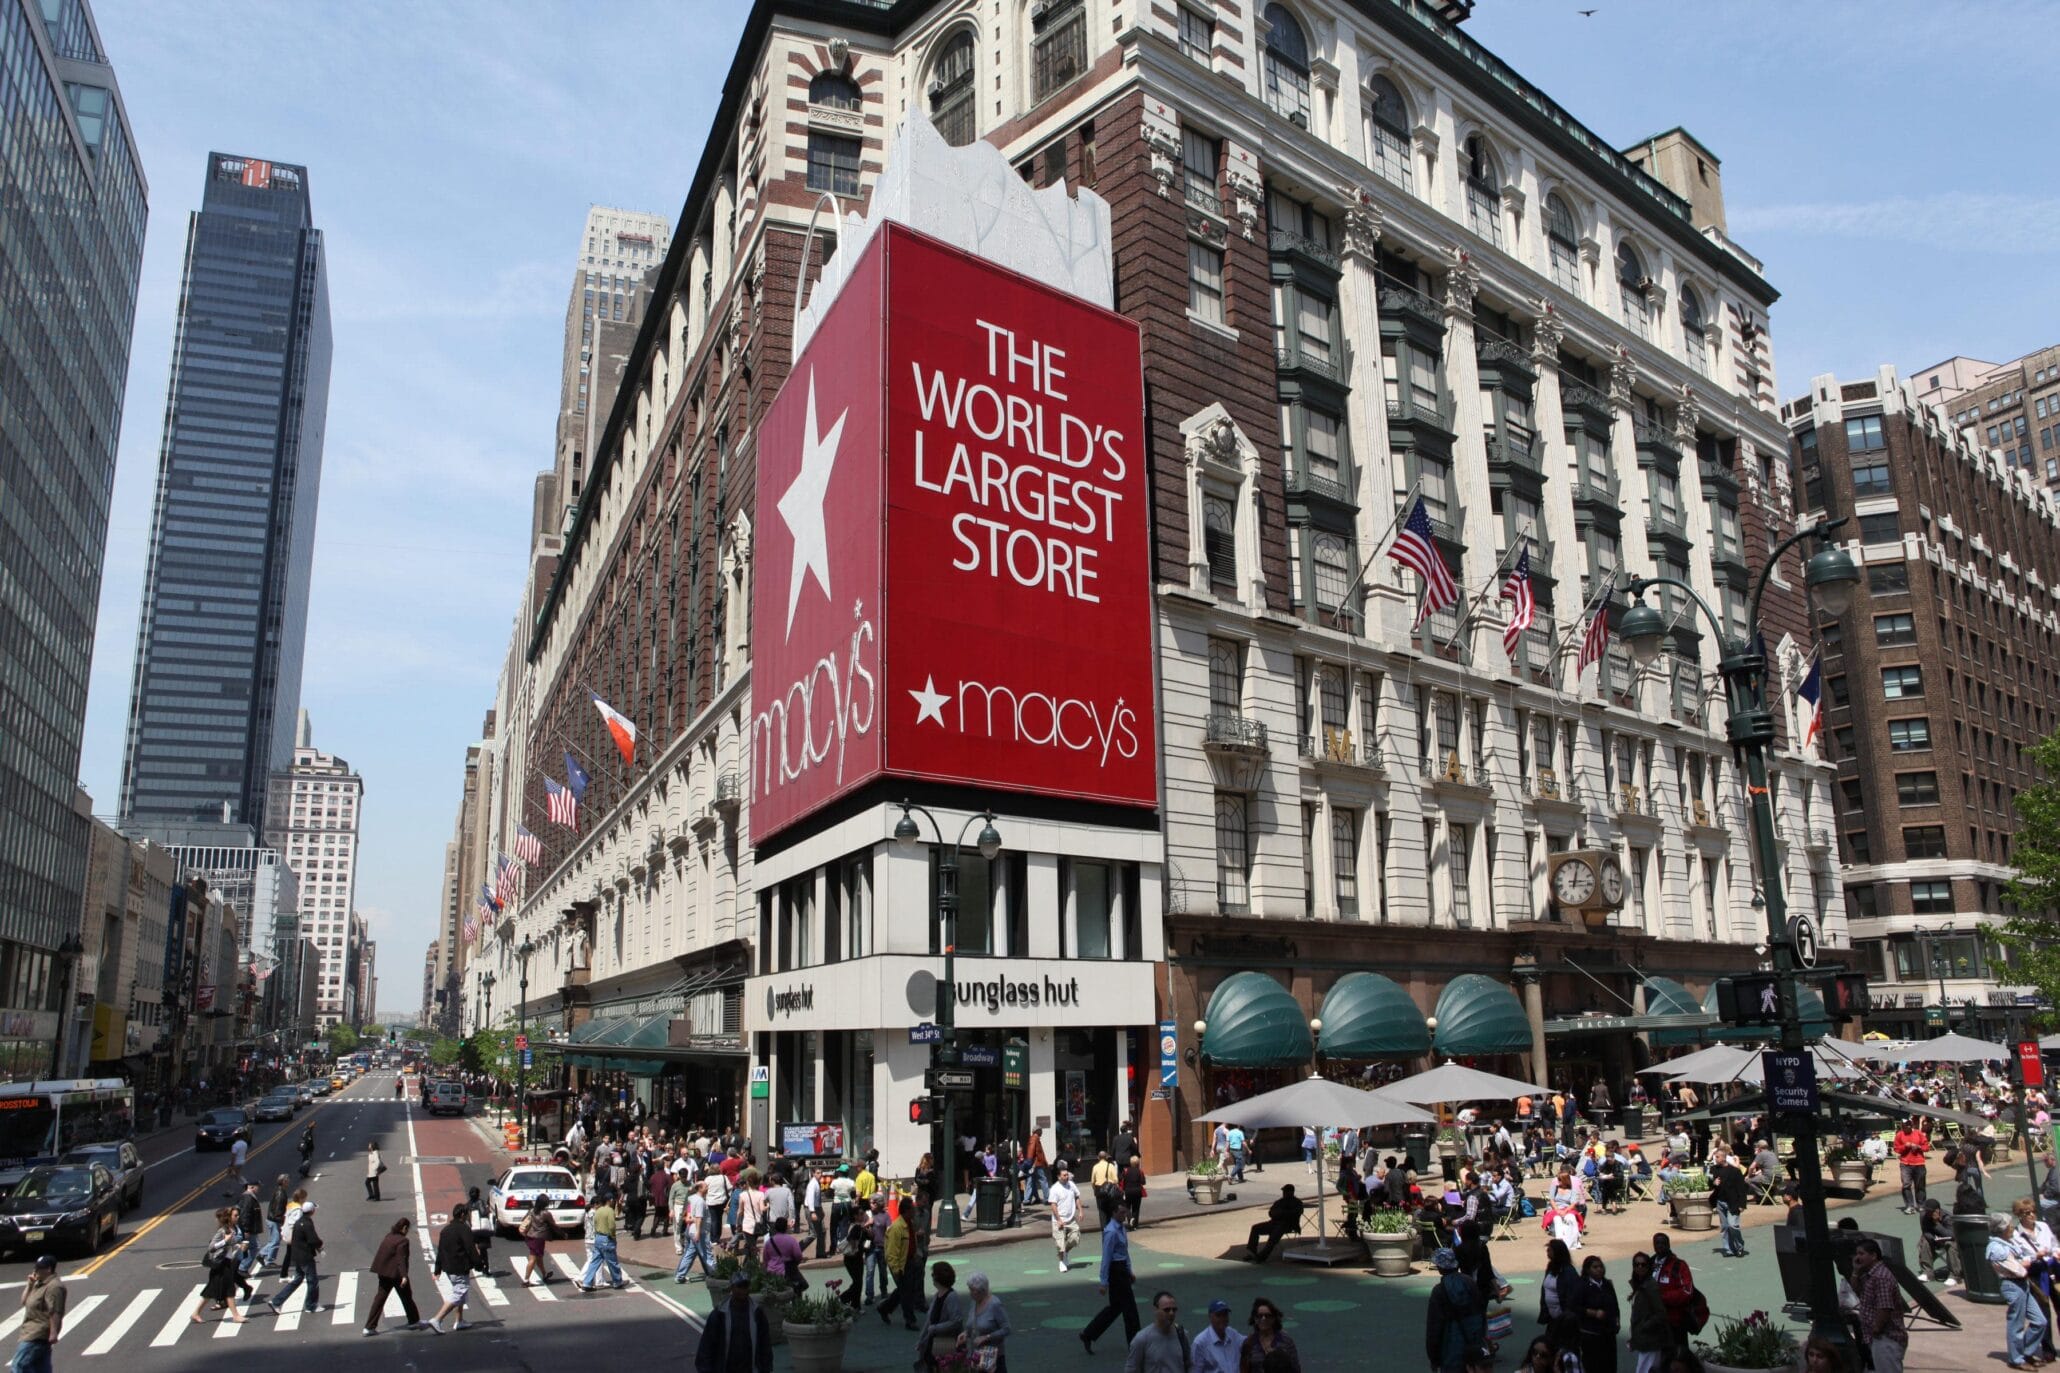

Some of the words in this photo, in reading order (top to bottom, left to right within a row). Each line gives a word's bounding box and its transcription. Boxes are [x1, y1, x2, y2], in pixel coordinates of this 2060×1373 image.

[976, 319, 1068, 402] THE
[912, 362, 1126, 481] WORLD'S
[914, 430, 1123, 542] LARGEST
[952, 512, 1100, 603] STORE
[958, 679, 1138, 767] macy's
[775, 984, 801, 1019] sunglass
[802, 982, 813, 1010] hut
[1045, 974, 1078, 1006] hut
[911, 1031, 924, 1040] West
[934, 1029, 940, 1039] St
[1577, 1020, 1625, 1028] MACY'S
[962, 1052, 994, 1064] Broadway
[1775, 1057, 1801, 1066] NYPD
[1774, 1086, 1808, 1097] Security
[1776, 1096, 1809, 1106] Camera
